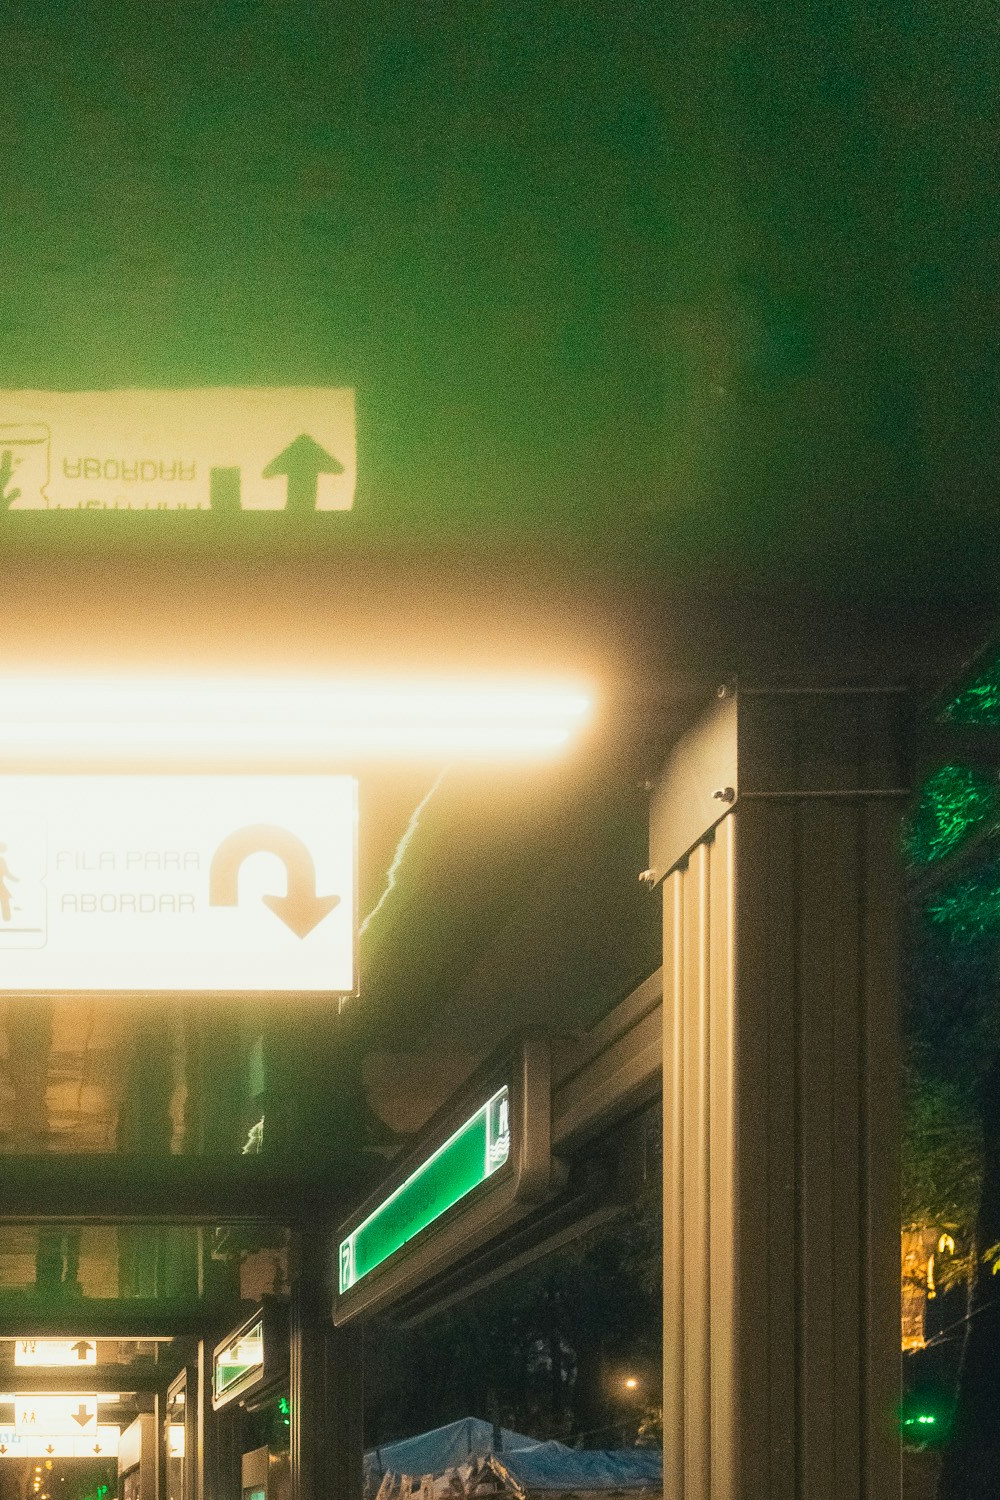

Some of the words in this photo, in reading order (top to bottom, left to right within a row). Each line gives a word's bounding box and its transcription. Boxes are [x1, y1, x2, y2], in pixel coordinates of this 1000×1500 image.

[56, 850, 115, 871] FILA
[126, 850, 200, 871] PARA
[61, 893, 195, 913] ABORDAR
